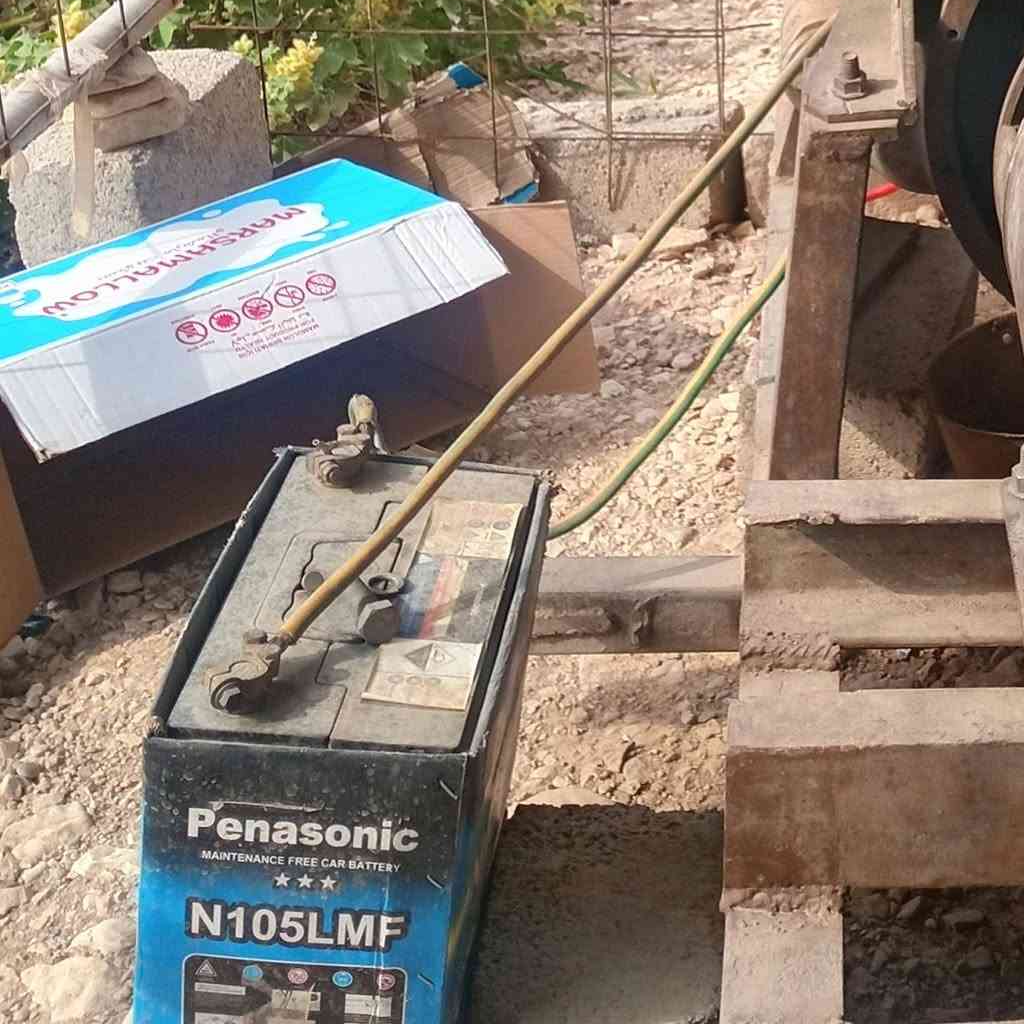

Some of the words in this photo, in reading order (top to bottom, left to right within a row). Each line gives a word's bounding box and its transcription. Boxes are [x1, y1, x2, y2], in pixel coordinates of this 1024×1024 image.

[42, 207, 306, 316] MARSHMALLOW
[187, 807, 419, 852] Penasonic
[200, 850, 285, 865] MAINTENANCE
[288, 856, 318, 868] FREE
[321, 858, 346, 869] CAR
[349, 860, 401, 872] BATTERY
[189, 901, 406, 949] N105LMF
